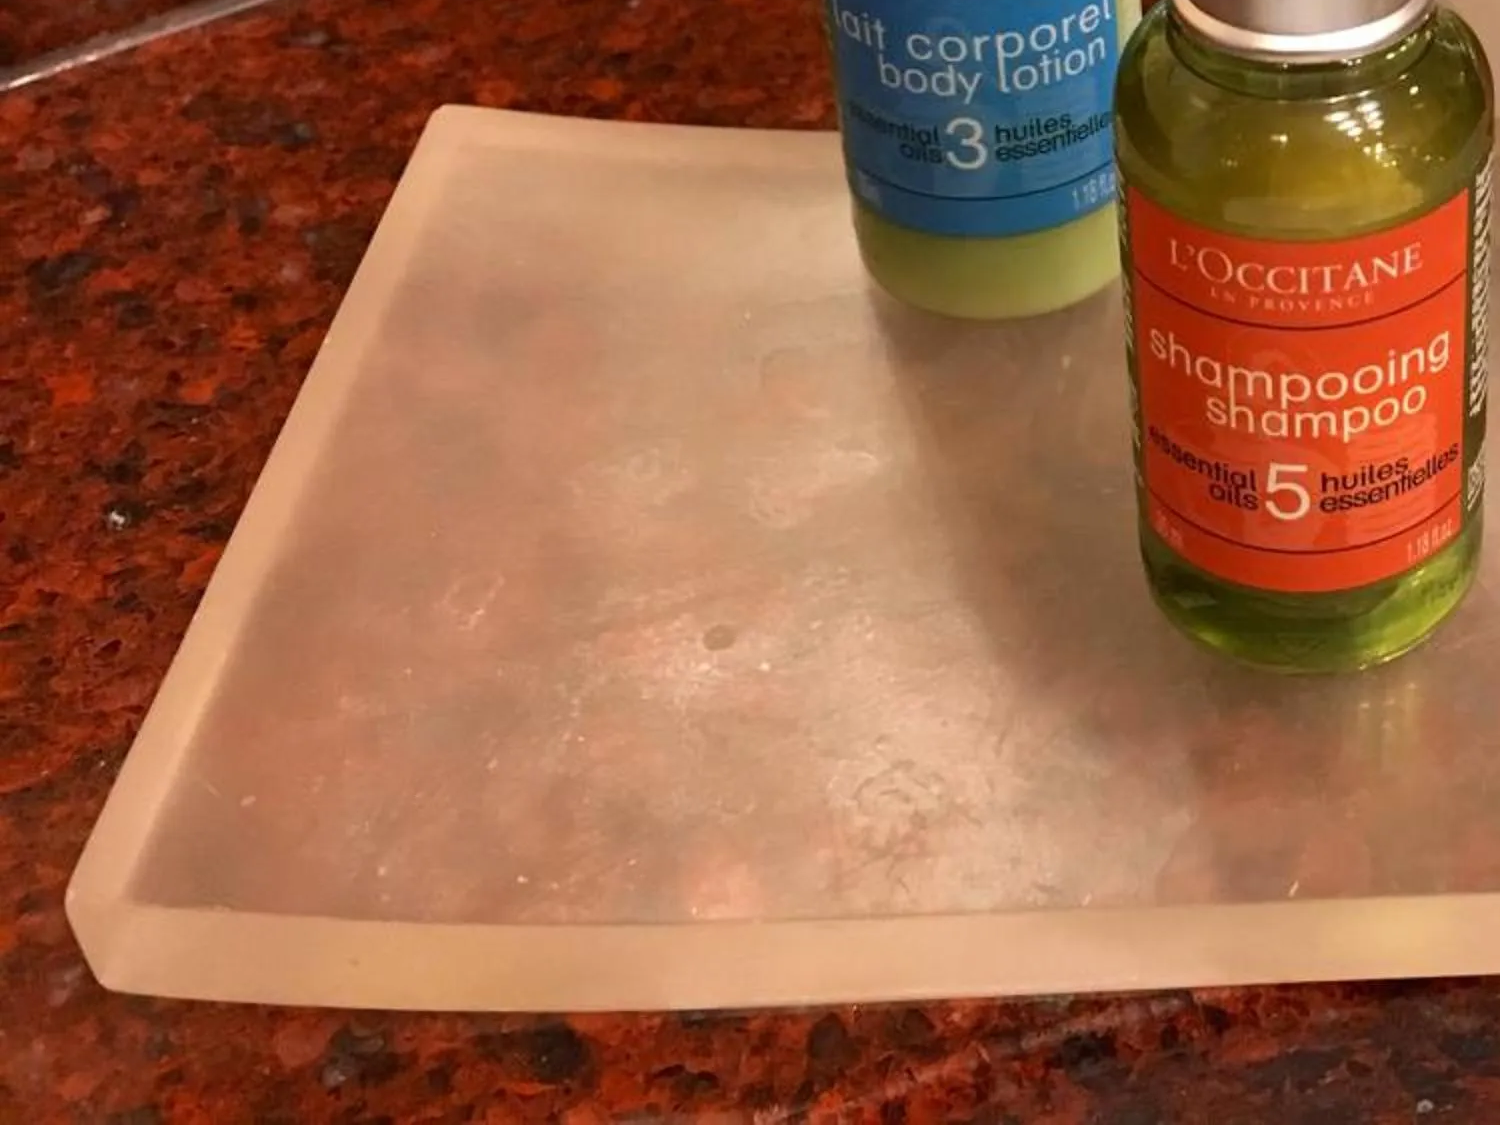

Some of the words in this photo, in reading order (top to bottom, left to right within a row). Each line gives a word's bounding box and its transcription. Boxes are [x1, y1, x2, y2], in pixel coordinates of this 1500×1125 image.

[878, 52, 982, 105] body
[998, 36, 1107, 94] lotion
[899, 143, 944, 165] oils
[994, 111, 1112, 163] essentielle
[945, 117, 988, 170] 3
[994, 113, 1072, 144] huiles
[1170, 239, 1424, 296] L'OCCITANE
[1209, 286, 1238, 305] EN
[1249, 291, 1376, 313] PROVENCE
[1150, 330, 1450, 409] shampooing
[1206, 381, 1428, 443] shampoo
[1148, 425, 1258, 493] essential
[1265, 463, 1311, 521] 5
[1321, 456, 1409, 493] huiles
[1208, 483, 1260, 512] oils
[1319, 442, 1460, 515] essentielles
